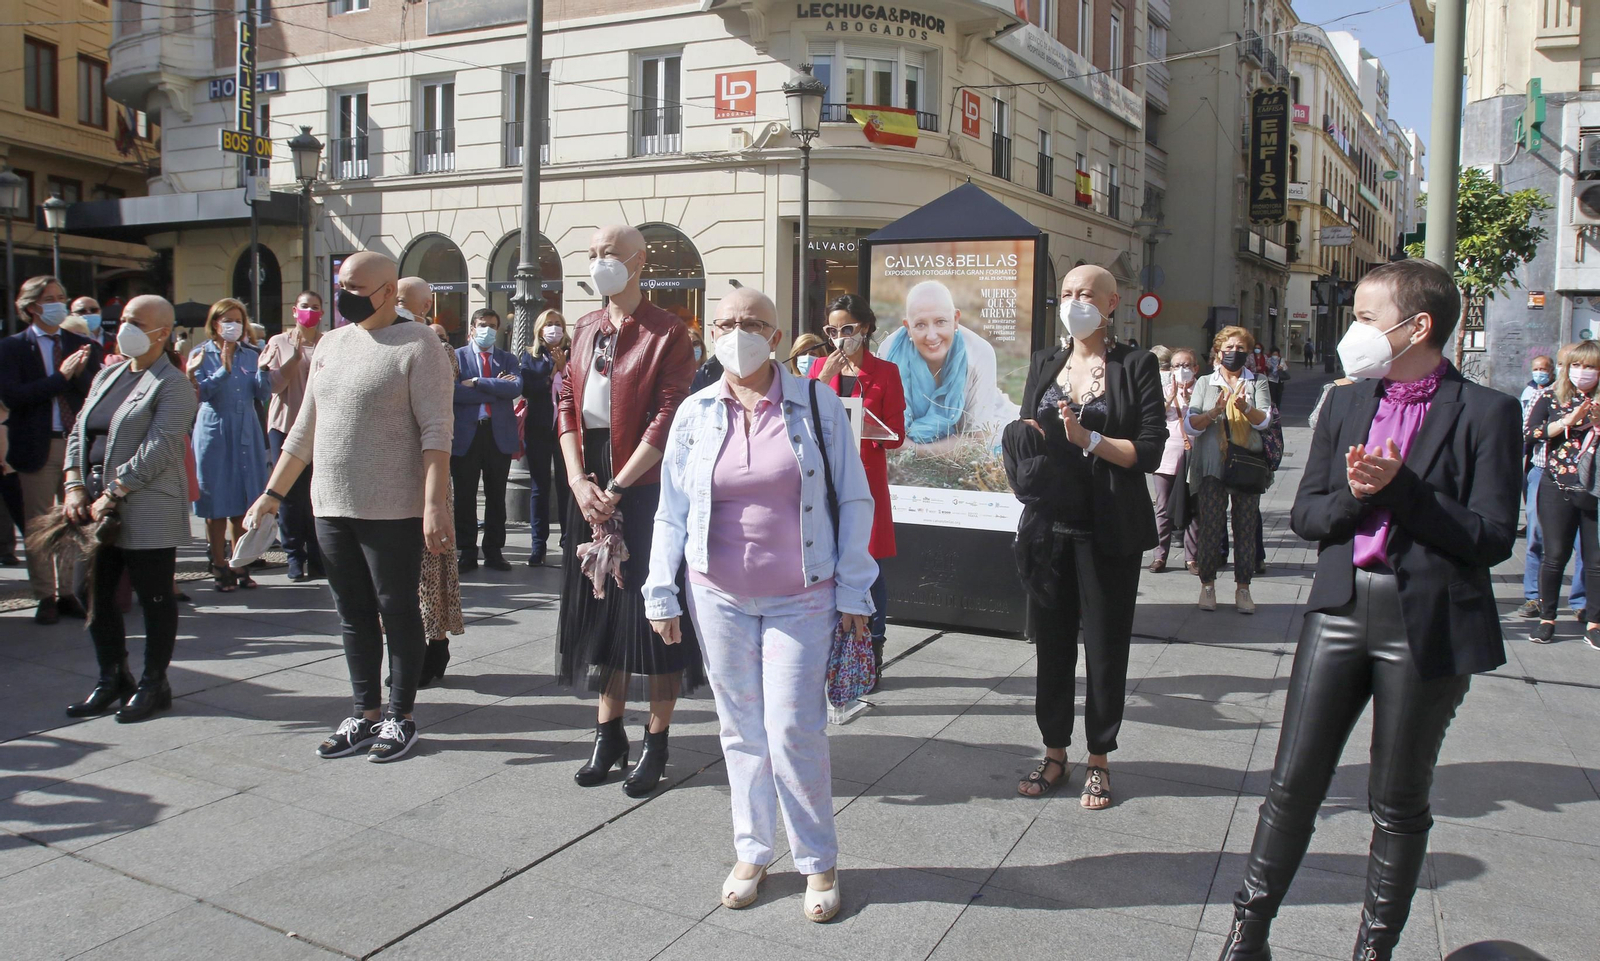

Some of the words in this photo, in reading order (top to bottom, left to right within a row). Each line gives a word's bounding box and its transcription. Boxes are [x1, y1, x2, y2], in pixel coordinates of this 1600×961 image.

[797, 3, 945, 34] LECHUGA&PRIOR
[826, 21, 928, 41] ABOGADOS
[210, 76, 275, 98] HOEL
[223, 131, 272, 156] BOSON
[1258, 119, 1278, 200] EMFISA
[807, 241, 856, 252] ALVARO
[885, 254, 1018, 268] CALVAS&BELLAS
[884, 269, 921, 277] EXPOSICIÓN
[922, 268, 966, 276] FOTOGRÁFICA
[980, 288, 1017, 299] MUJERES
[987, 298, 1004, 309] QUE
[1005, 298, 1017, 308] SE
[1469, 296, 1484, 307] AR
[980, 308, 1017, 318] ATREVEN
